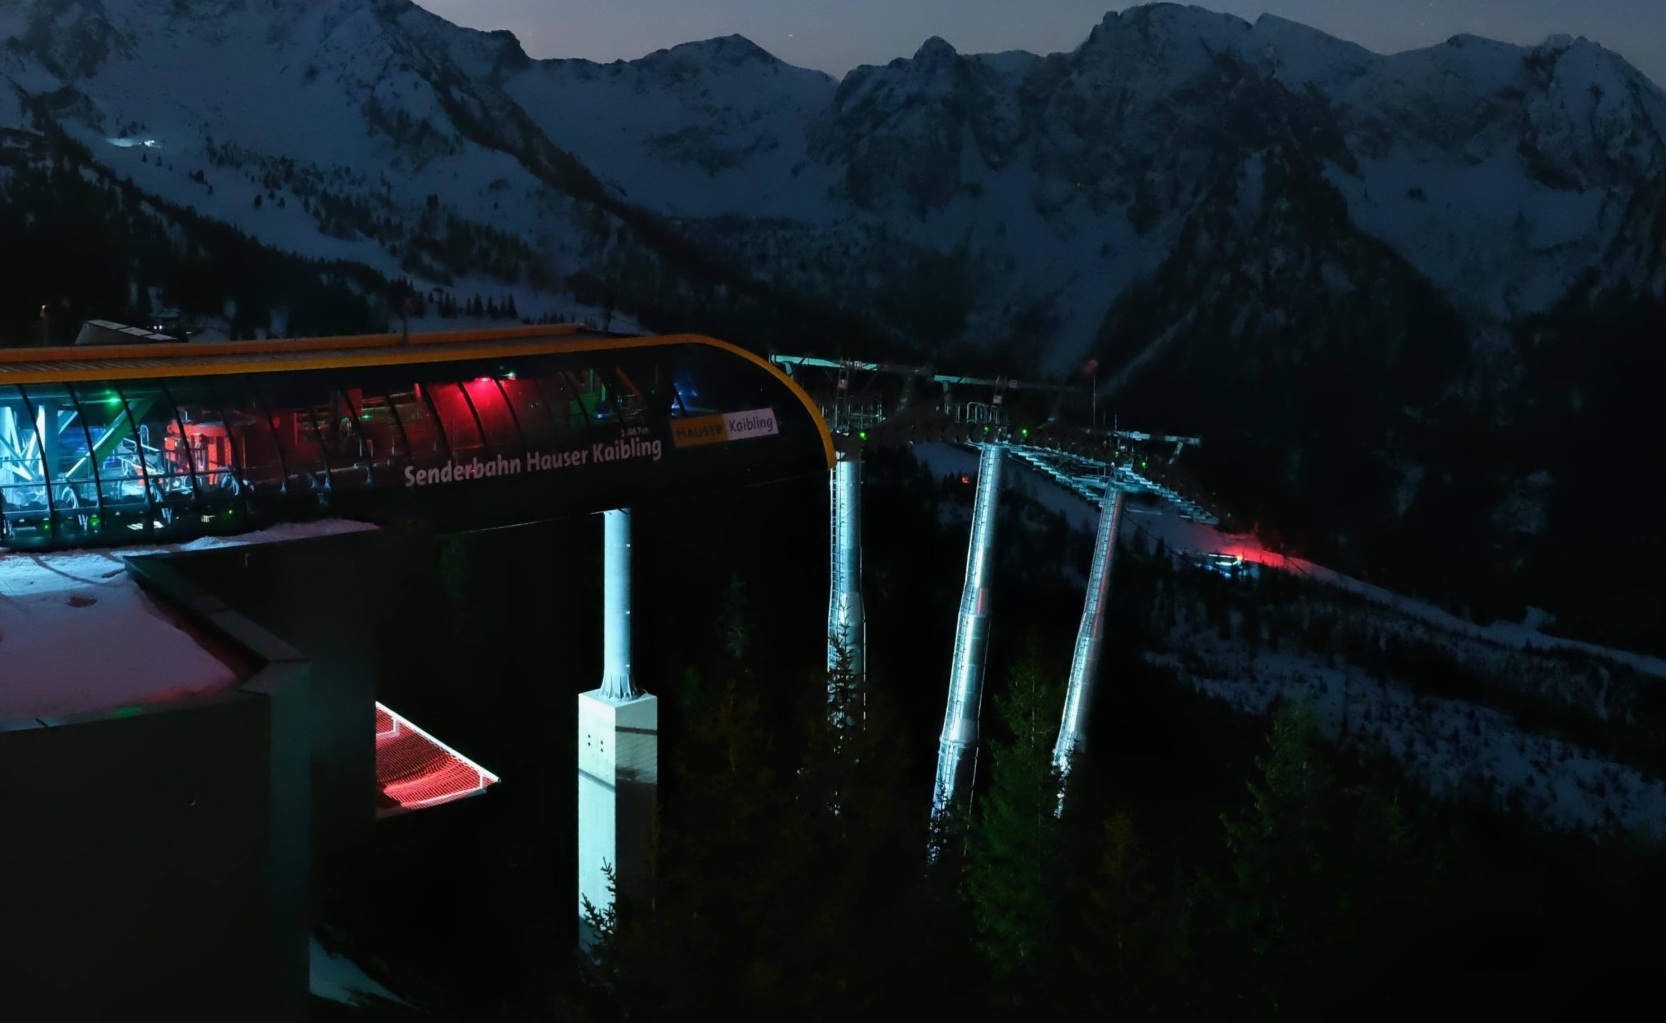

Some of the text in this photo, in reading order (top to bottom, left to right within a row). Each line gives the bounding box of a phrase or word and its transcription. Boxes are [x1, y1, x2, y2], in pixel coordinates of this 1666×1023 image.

[676, 414, 775, 440] HAUSER Kaibling
[404, 438, 663, 488] Senderbahn Hauser Kaibling
